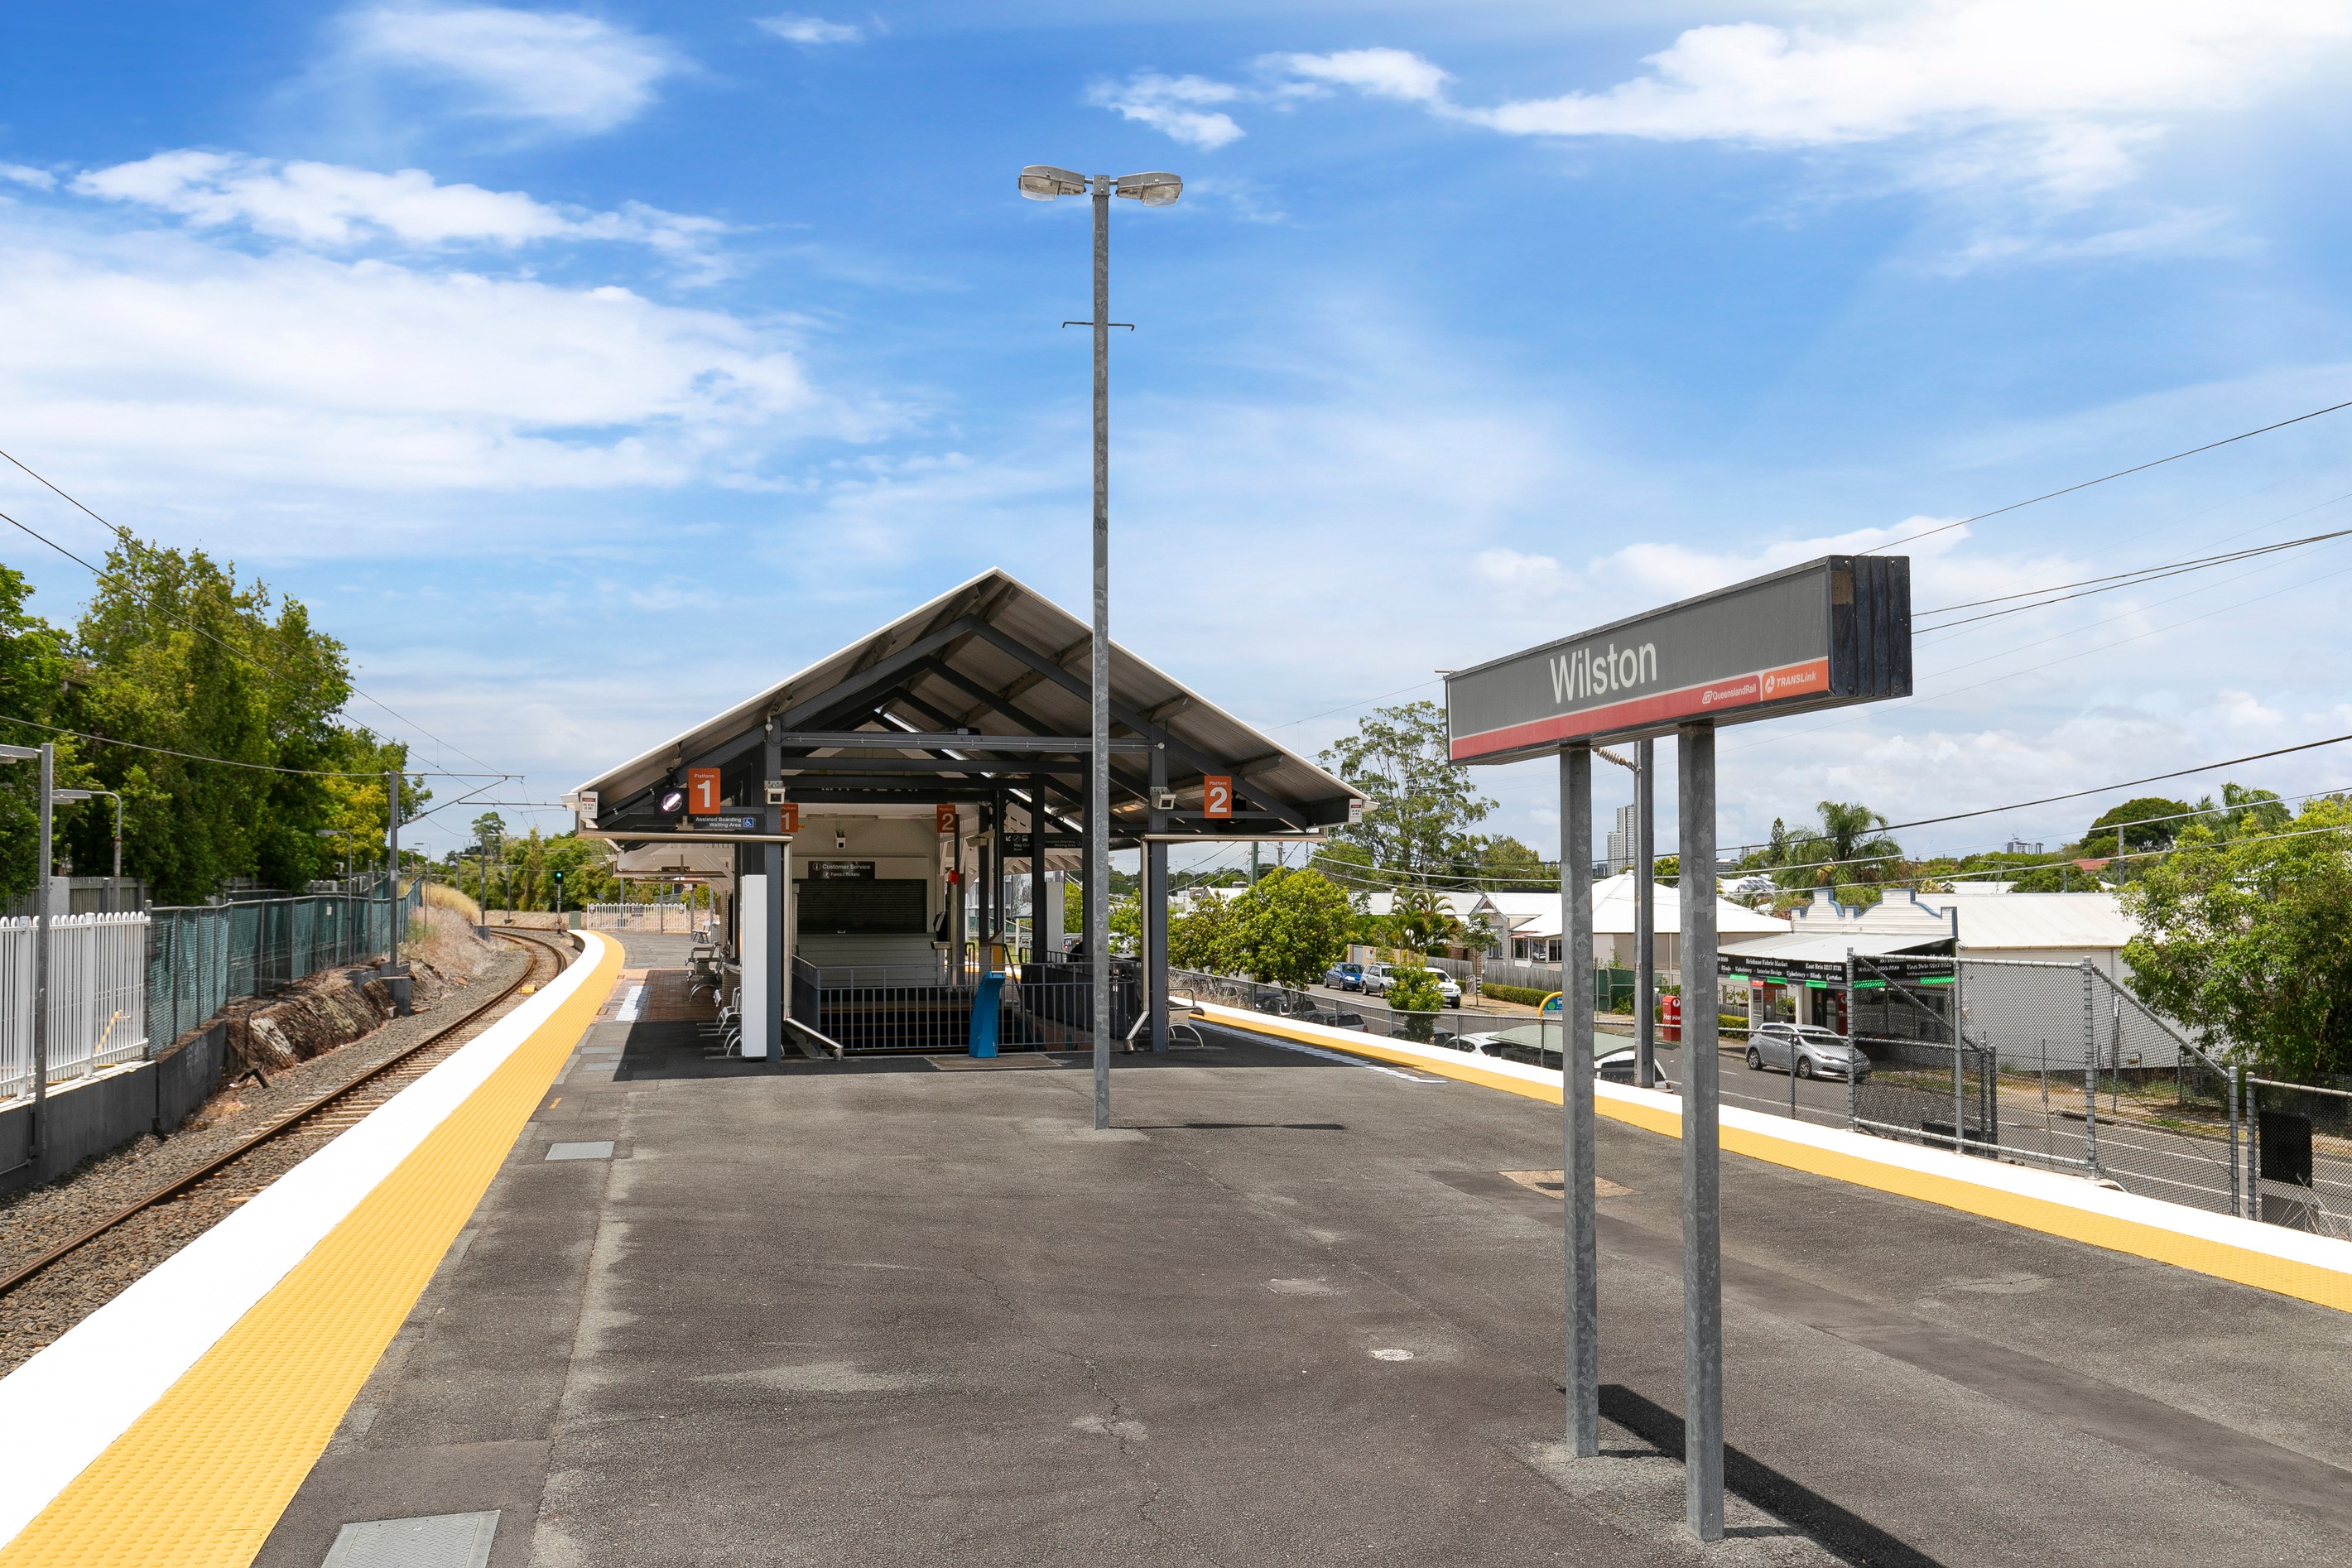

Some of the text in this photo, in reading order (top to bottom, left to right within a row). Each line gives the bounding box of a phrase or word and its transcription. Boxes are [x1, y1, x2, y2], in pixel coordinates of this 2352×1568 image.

[1549, 642, 1657, 704] Wilston
[1776, 671, 1817, 688] TRANSLink
[1712, 683, 1757, 701] QueenslandRail
[697, 780, 710, 808] 1
[1209, 786, 1228, 813] 2
[781, 812, 790, 830] 1
[941, 813, 955, 830] 2
[1735, 965, 1753, 974] Upholstery
[1787, 969, 1806, 979] Upholstery
